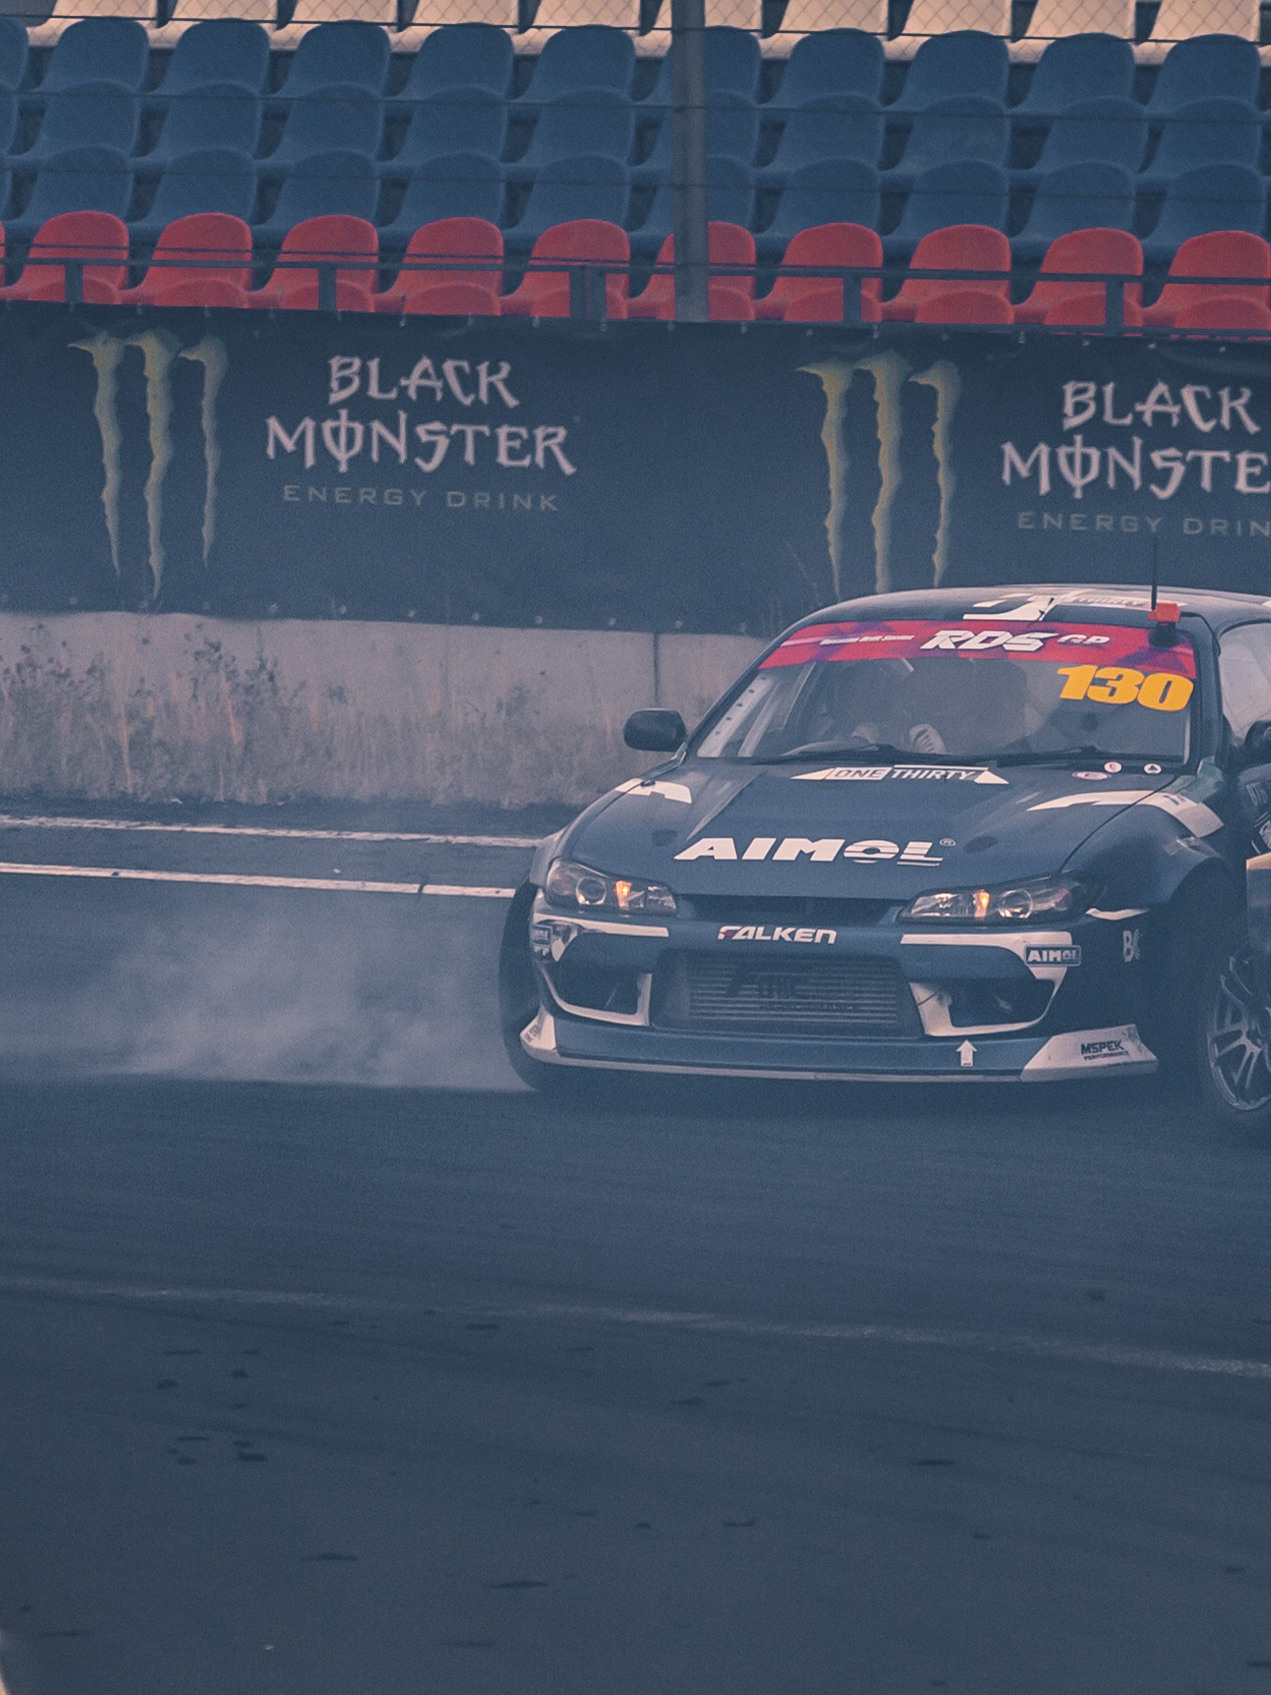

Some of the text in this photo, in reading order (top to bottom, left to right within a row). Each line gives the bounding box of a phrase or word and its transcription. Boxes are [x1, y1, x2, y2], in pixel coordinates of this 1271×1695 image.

[328, 355, 520, 408] BLACK
[1062, 379, 1261, 434] BLACK
[265, 409, 578, 477] MONSTER
[282, 484, 561, 513] ENERGY DRINK
[1016, 510, 1165, 536] ENERGY
[920, 629, 1060, 653] RDS
[1056, 664, 1195, 712] 130
[834, 767, 977, 780] ONE THIRTY
[673, 836, 944, 867] AIMOL
[717, 924, 838, 945] FALKEN
[1081, 1040, 1124, 1055] MSPEK
